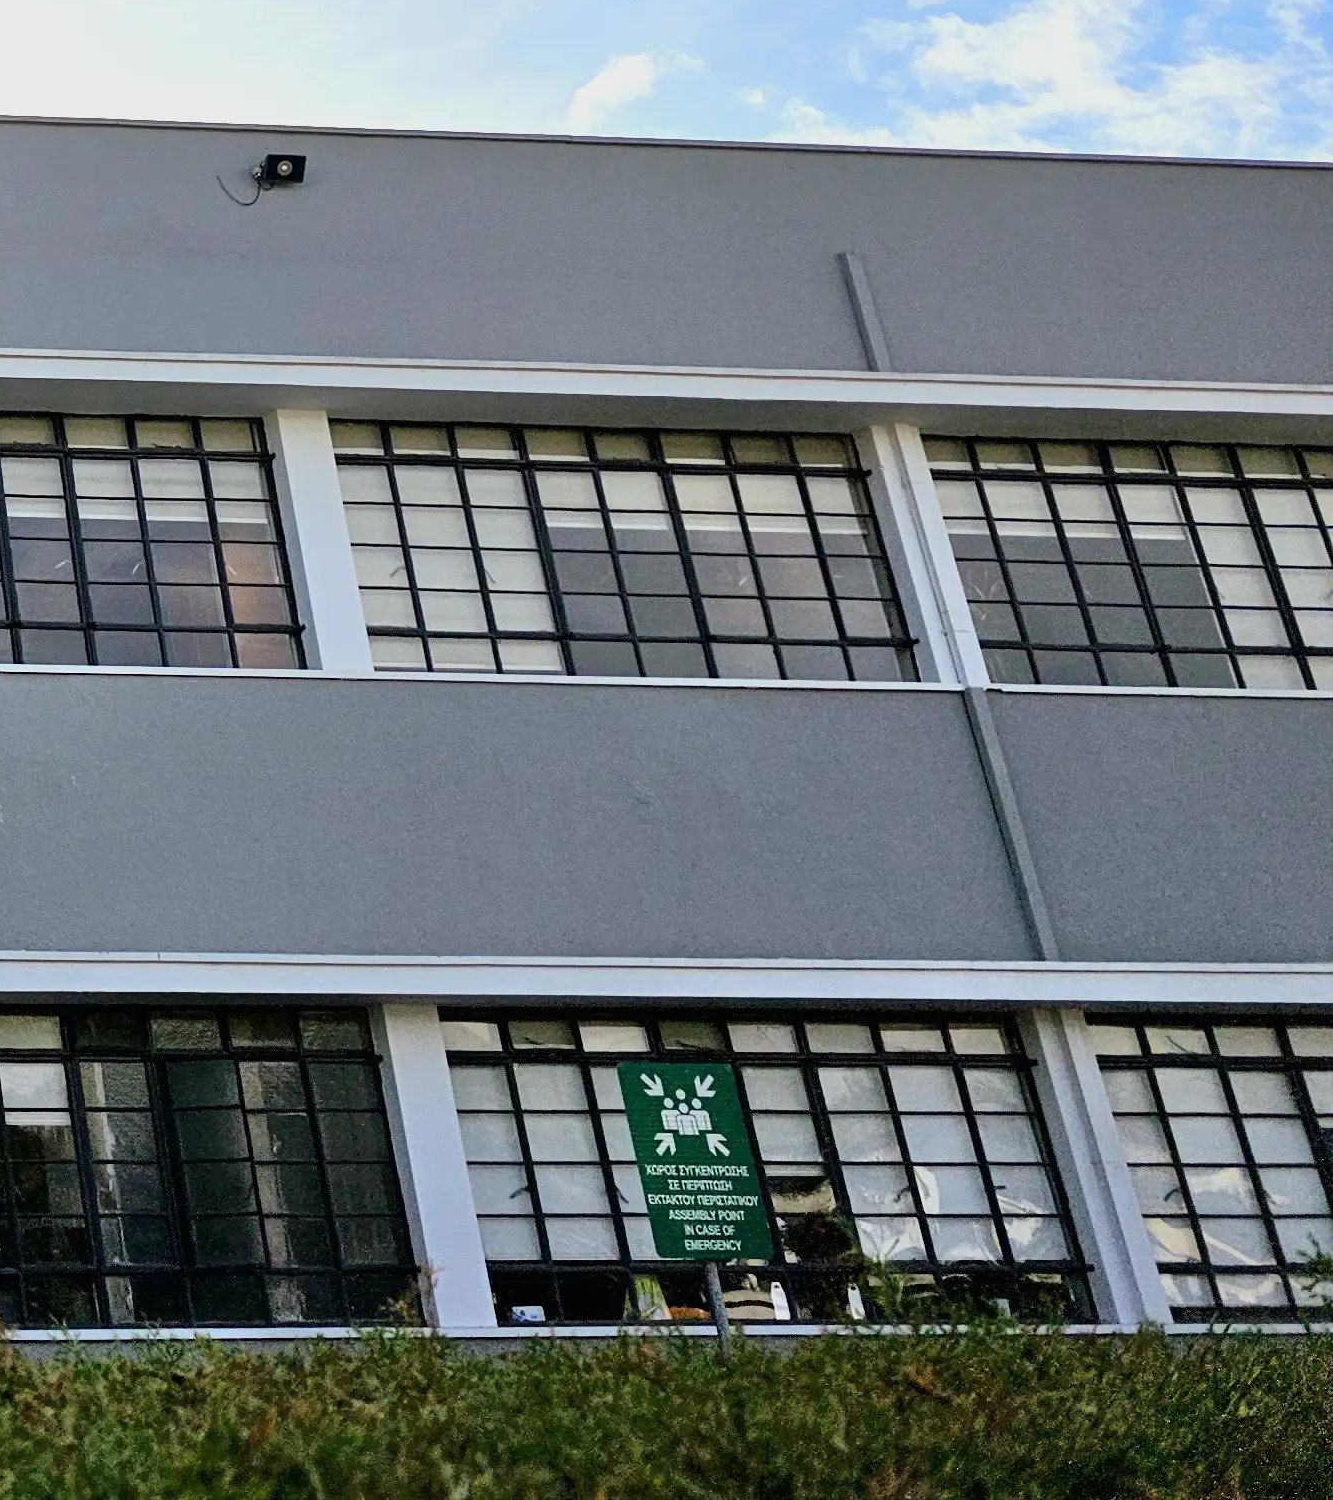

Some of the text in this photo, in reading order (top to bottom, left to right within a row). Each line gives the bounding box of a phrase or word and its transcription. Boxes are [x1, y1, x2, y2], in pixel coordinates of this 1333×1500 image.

[645, 1165, 749, 1177] ΧΩΡΟΣ ΣΥΓΚΕΝΤΡΩΣΗΣ
[668, 1180, 733, 1191] ΣΕ ΠΕΡΙΠΤΩΣΗ
[648, 1194, 758, 1206] ΕΚΤΑΚΤΟΥ ΠΕΡΙΣΤΑΤΙΚΟΥ
[669, 1210, 745, 1221] ASSEMBLY POINT
[684, 1225, 735, 1236] IN CASE OF
[685, 1240, 741, 1251] EMERGENCY
